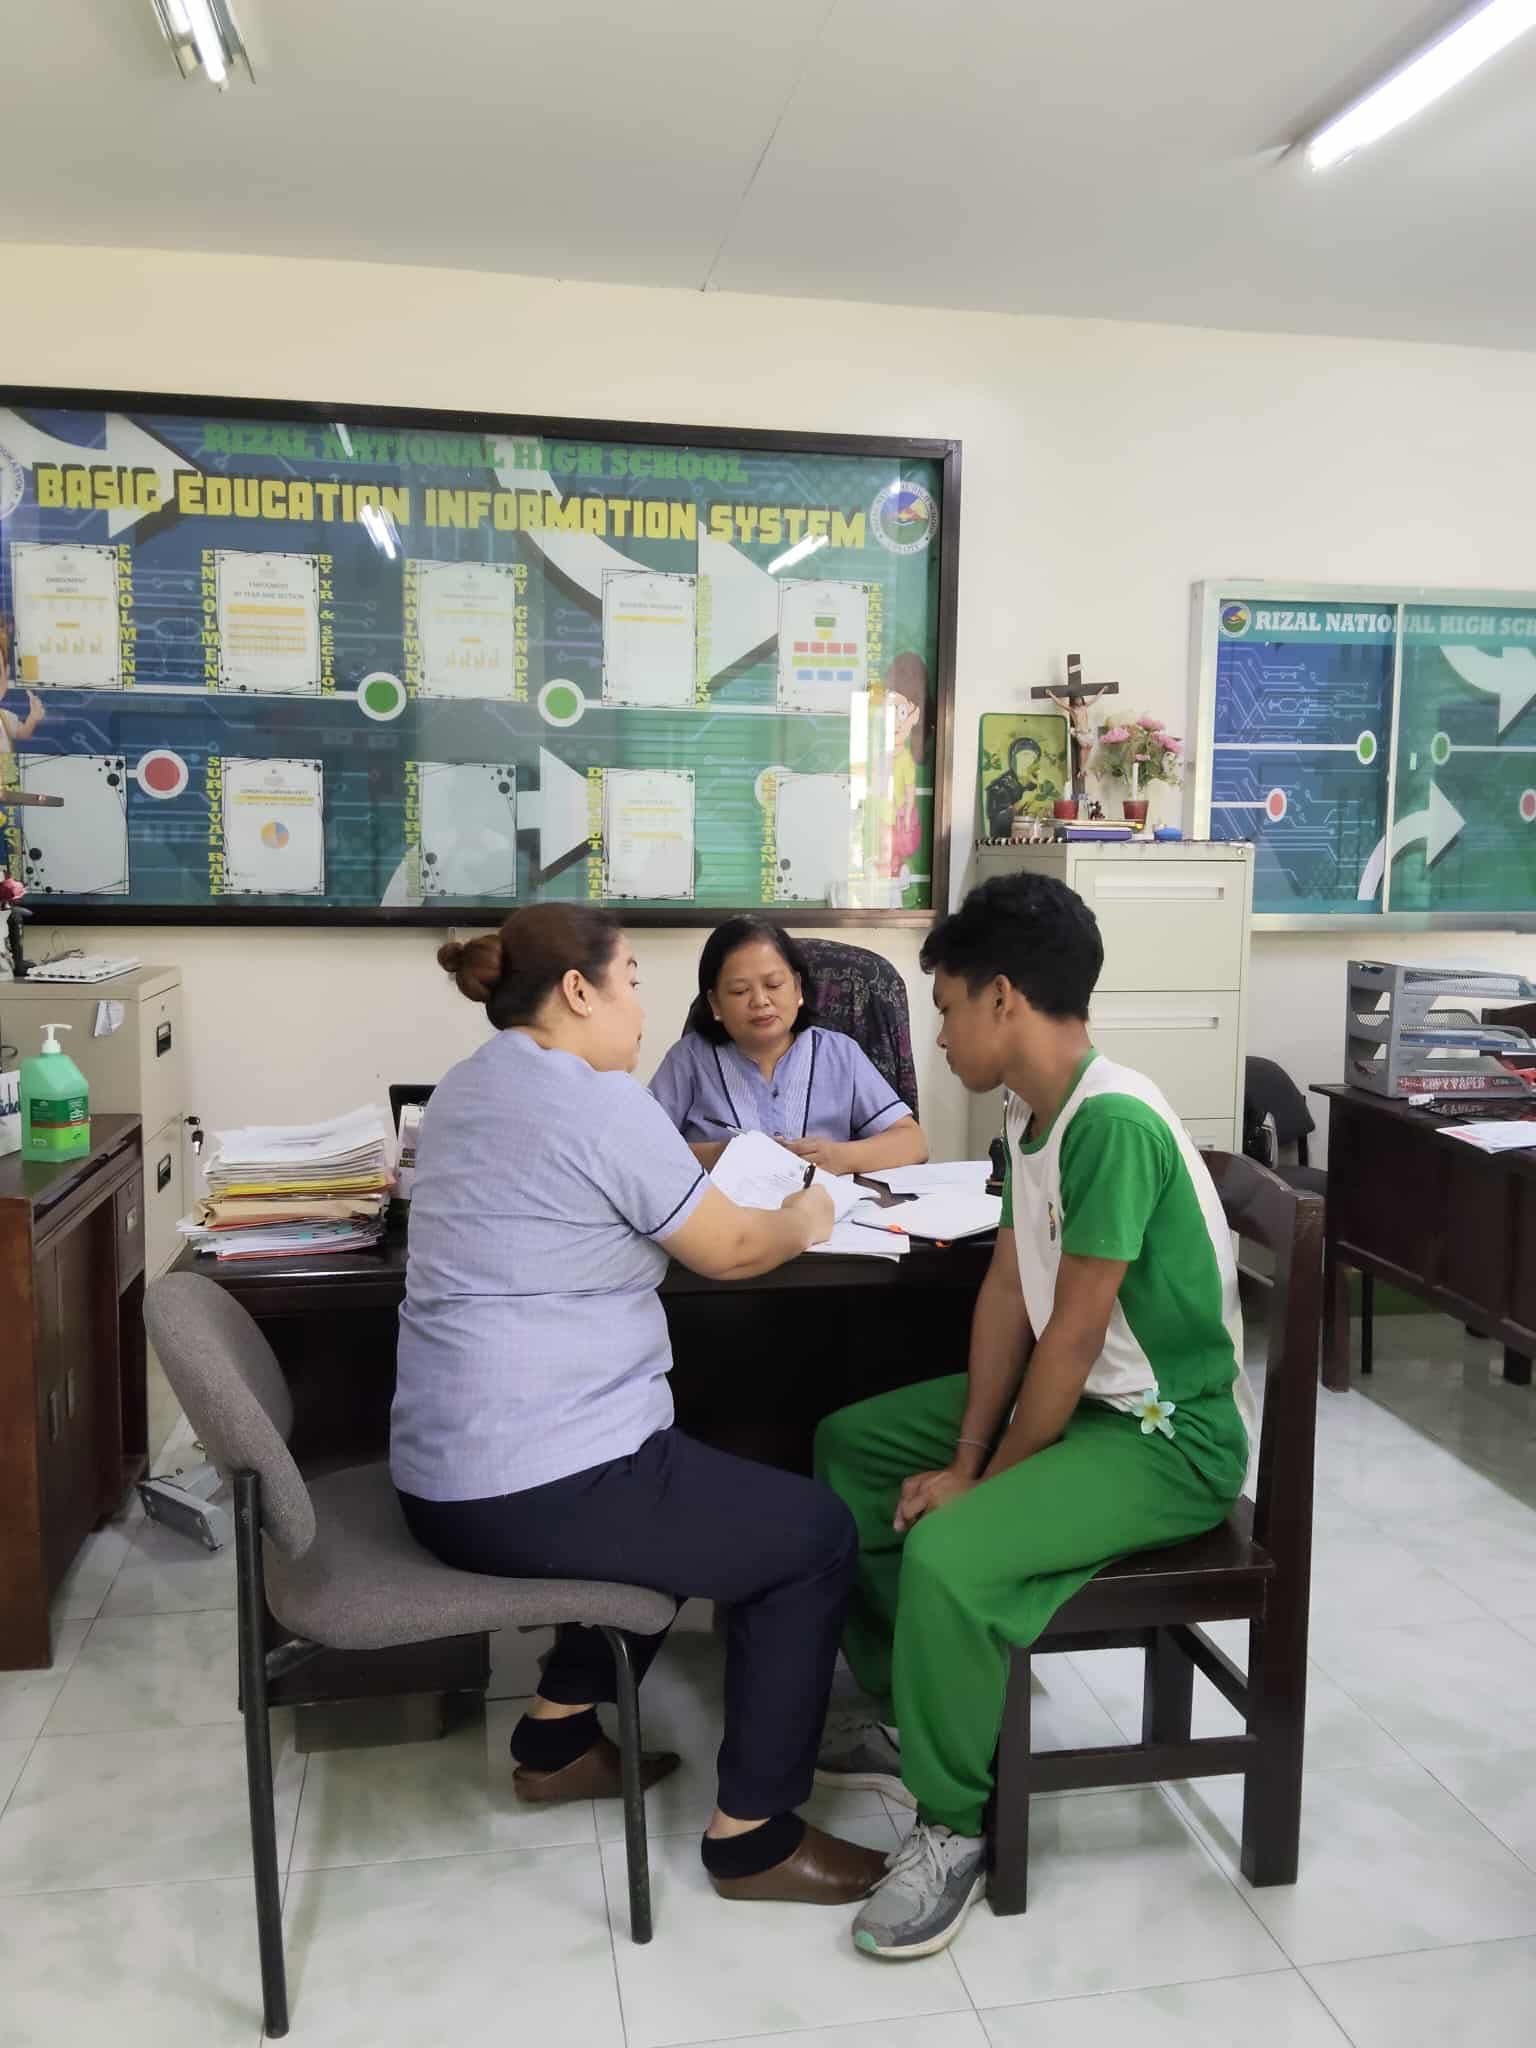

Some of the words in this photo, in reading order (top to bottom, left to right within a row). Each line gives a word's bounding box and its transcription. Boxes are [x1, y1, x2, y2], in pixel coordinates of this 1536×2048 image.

[203, 424, 314, 456] RIZAL
[323, 429, 504, 468] NATIONAL
[512, 436, 603, 475] HIGH
[611, 447, 750, 483] SCHOOL
[34, 464, 161, 512] BASIC
[176, 471, 410, 525] EDUCATION
[424, 487, 697, 541] INFORMATION
[709, 502, 866, 549] SYSTEM
[320, 554, 333, 574] BY
[515, 563, 528, 594] BY
[117, 544, 136, 688] ENROLMENT
[201, 550, 219, 694] ENROLMENT
[320, 609, 335, 620] &
[404, 559, 418, 698] ENROLMENT
[1256, 611, 1321, 631] RIZAL
[1325, 613, 1434, 634] NATIONAL
[1440, 615, 1496, 635] HIGH
[321, 625, 336, 696] SECTION
[514, 606, 528, 702] GENDER
[206, 757, 223, 845] SURVIVAL
[404, 761, 420, 845] FAILURE
[208, 852, 224, 895] RATE
